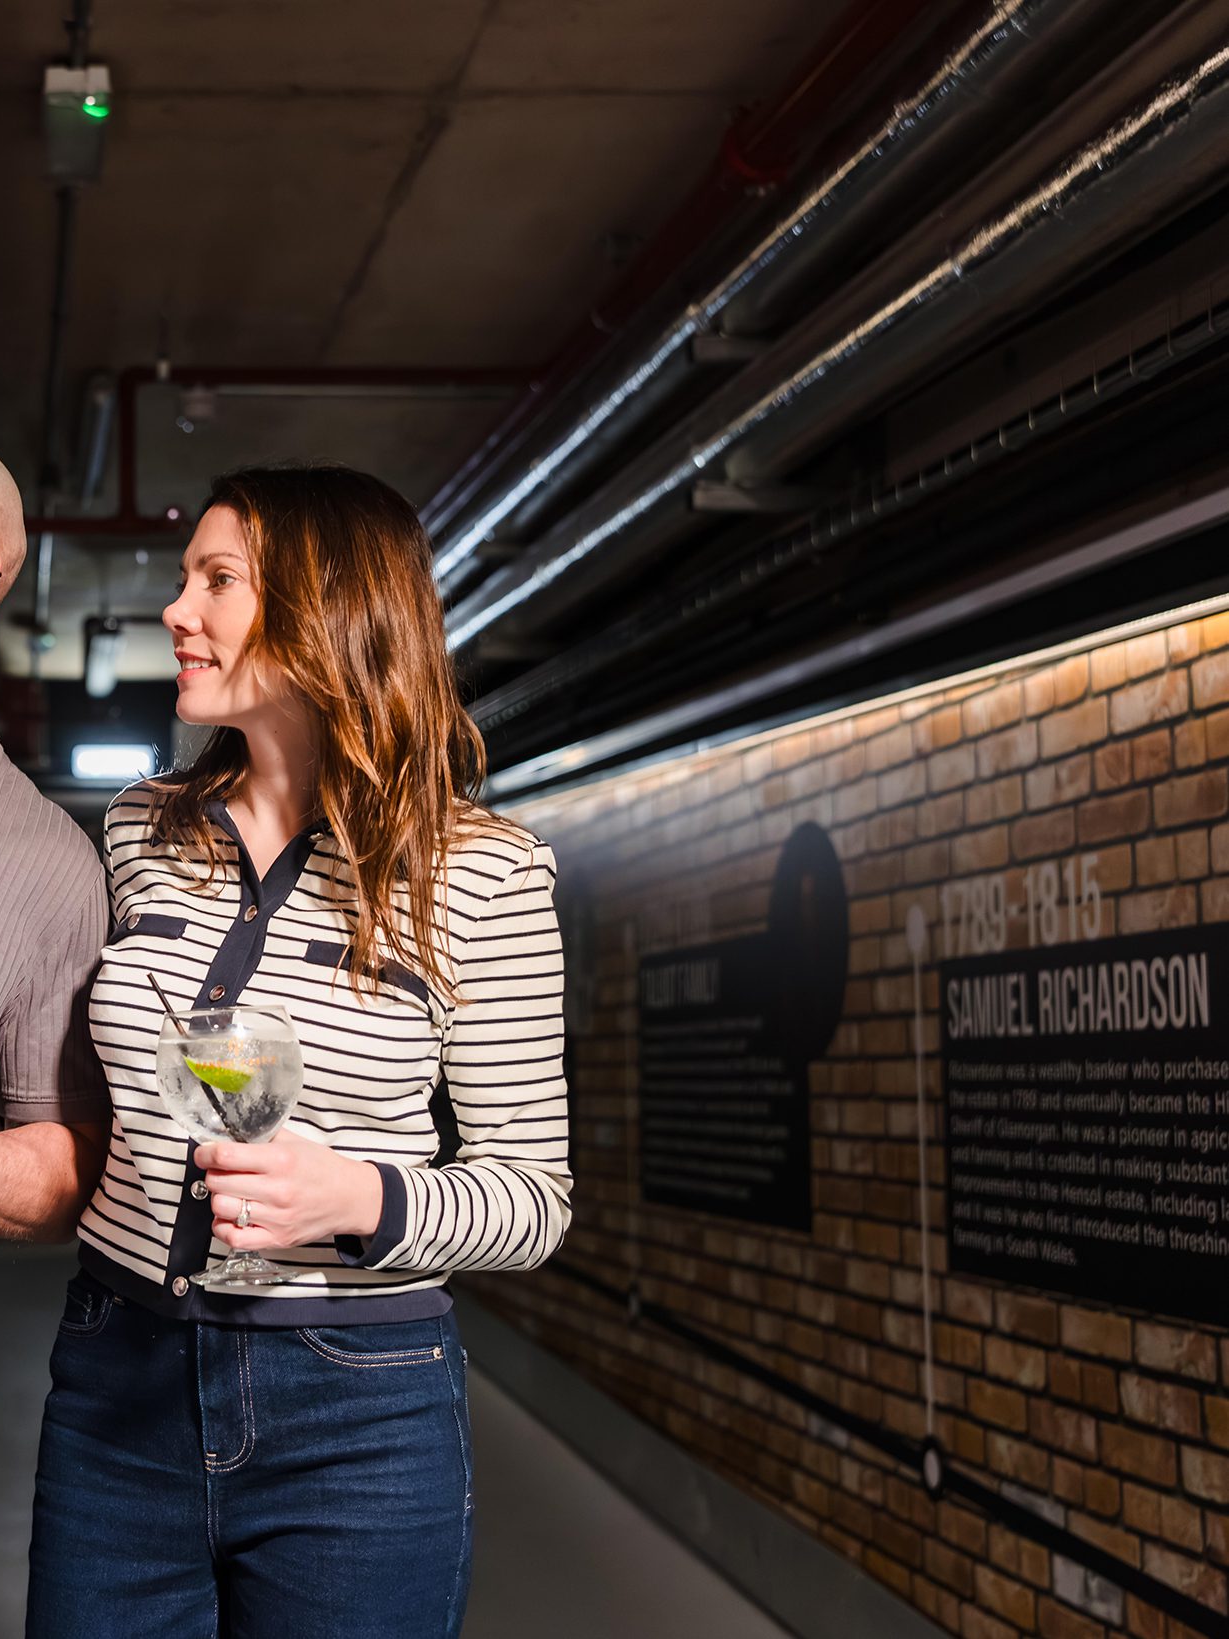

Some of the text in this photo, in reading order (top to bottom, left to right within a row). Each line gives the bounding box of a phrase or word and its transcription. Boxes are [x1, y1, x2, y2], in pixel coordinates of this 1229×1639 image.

[940, 853, 1102, 958] 1789-1815
[946, 952, 1209, 1040] SAMUEL RICHARDSON
[1006, 1063, 1026, 1080] was
[1028, 1063, 1036, 1080] a
[1038, 1059, 1082, 1085] wealthy
[1085, 1058, 1129, 1080] banker
[1132, 1057, 1160, 1080] who
[1012, 1089, 1037, 1110] 1789
[1039, 1090, 1060, 1111] and
[1064, 1090, 1126, 1116] eventually
[1129, 1090, 1183, 1114] became
[1186, 1090, 1211, 1115] the
[1062, 1120, 1079, 1142] He
[1081, 1124, 1106, 1143] was
[1108, 1125, 1117, 1143] a
[1119, 1123, 1170, 1148] pioneer
[1173, 1124, 1188, 1148] in
[1191, 1125, 1229, 1153] agric
[1012, 1149, 1032, 1169] and
[1048, 1151, 1096, 1174] credited
[1099, 1152, 1111, 1176] in
[1113, 1156, 1162, 1184] making
[1166, 1158, 1229, 1186] substant
[1025, 1179, 1039, 1200] to
[1040, 1180, 1059, 1201] the
[1061, 1181, 1102, 1206] Hensol
[1104, 1187, 1148, 1215] estate,
[1151, 1189, 1218, 1224] including
[983, 1206, 1002, 1224] was
[1004, 1205, 1019, 1226] he
[1021, 1209, 1044, 1231] who
[1047, 1208, 1070, 1234] first
[1072, 1213, 1140, 1245] introduced
[1143, 1221, 1167, 1247] the
[1169, 1224, 1229, 1257] threshin
[1006, 1232, 1038, 1259] South
[1040, 1239, 1077, 1267] Wales.
